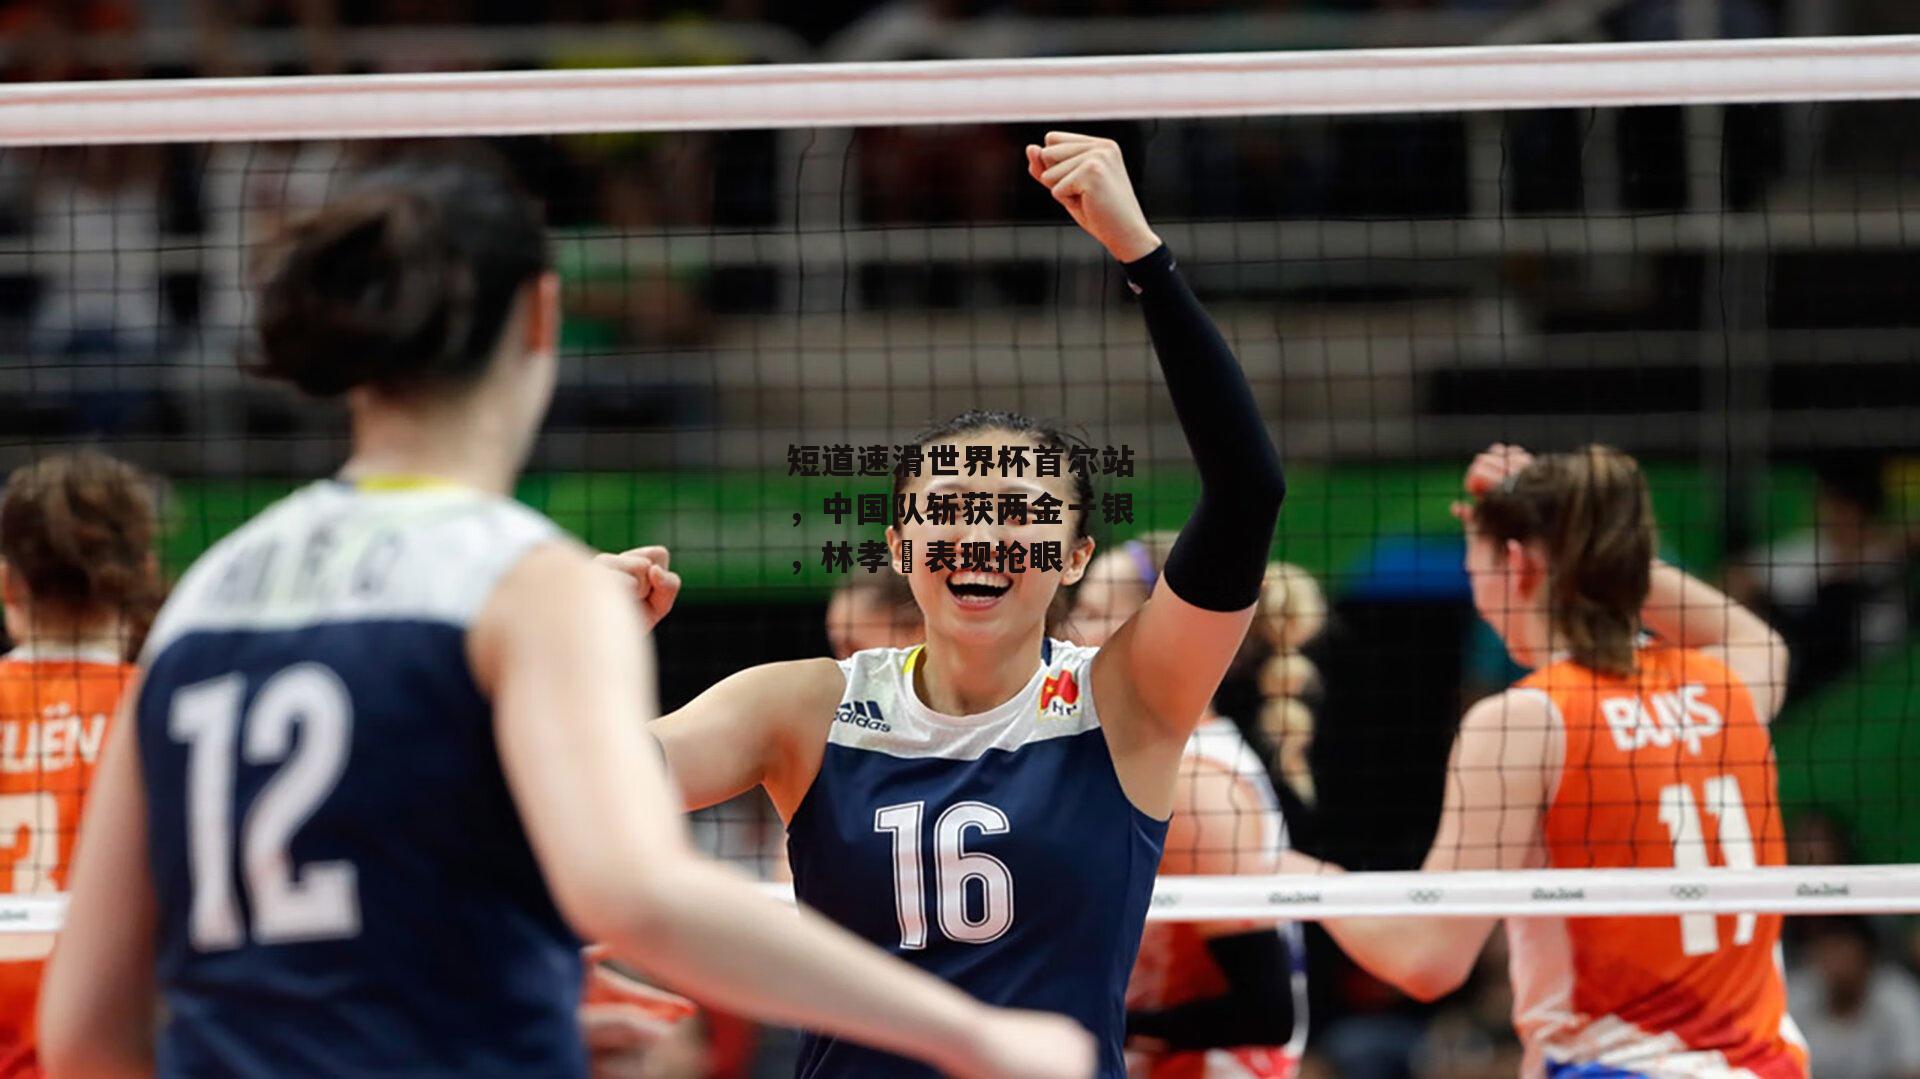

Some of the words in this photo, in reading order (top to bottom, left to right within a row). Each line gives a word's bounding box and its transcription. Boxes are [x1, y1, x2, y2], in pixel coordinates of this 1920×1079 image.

[167, 661, 363, 953] 12
[874, 800, 1015, 951] 16
[1658, 774, 1758, 957] 11
